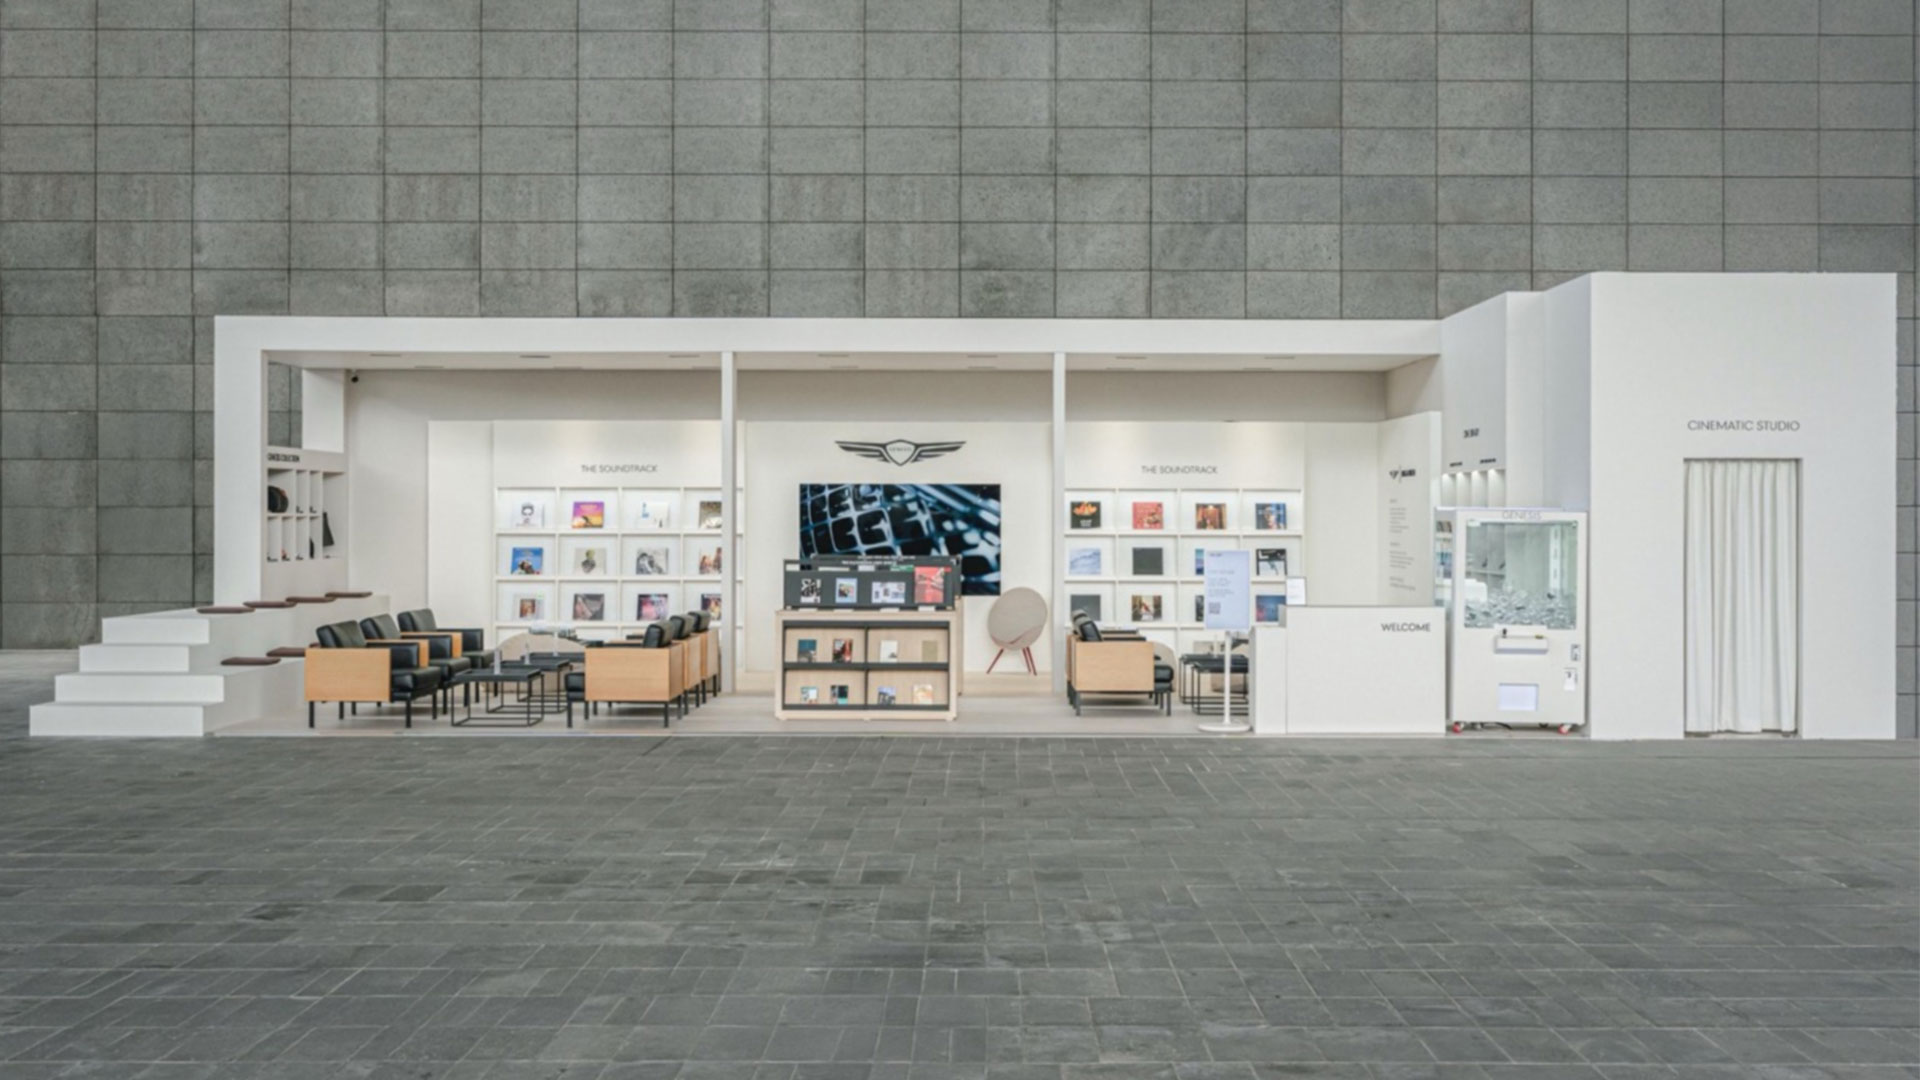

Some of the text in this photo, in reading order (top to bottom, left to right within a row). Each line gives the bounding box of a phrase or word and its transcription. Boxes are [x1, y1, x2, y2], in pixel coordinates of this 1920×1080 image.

[1687, 419, 1801, 432] CINEMATIC STUDIO
[581, 463, 658, 474] THE SOUNDTRACK
[1141, 464, 1218, 475] THE SOUNDTRACK
[1502, 510, 1542, 520] GENESIS
[1380, 621, 1431, 632] WELCOME
